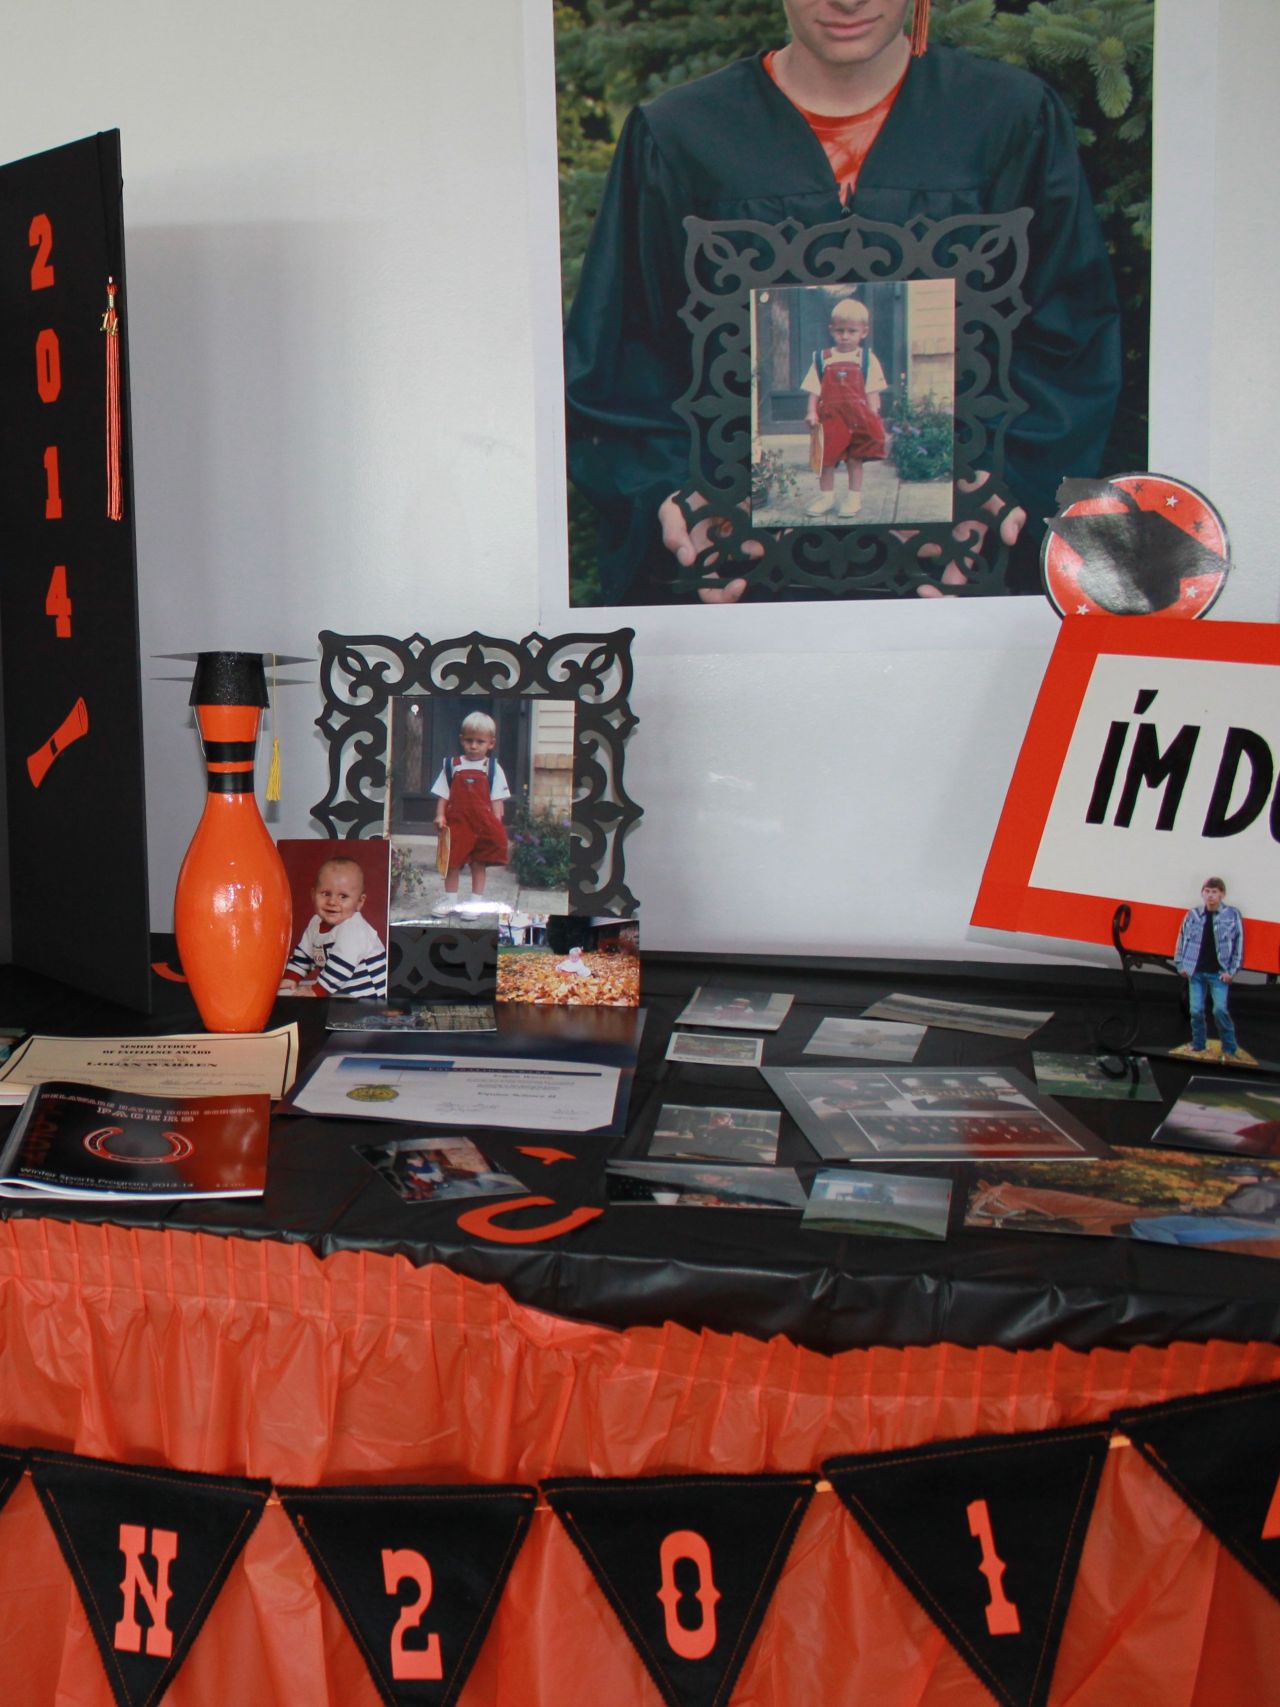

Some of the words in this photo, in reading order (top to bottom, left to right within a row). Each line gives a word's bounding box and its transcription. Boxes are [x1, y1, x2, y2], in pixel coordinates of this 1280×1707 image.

[1085, 689, 1201, 832] I'M
[1201, 726, 1280, 844] D
[97, 1107, 195, 1123] PACERS
[20, 1167, 57, 1178] Winter
[98, 1178, 149, 1188] Program
